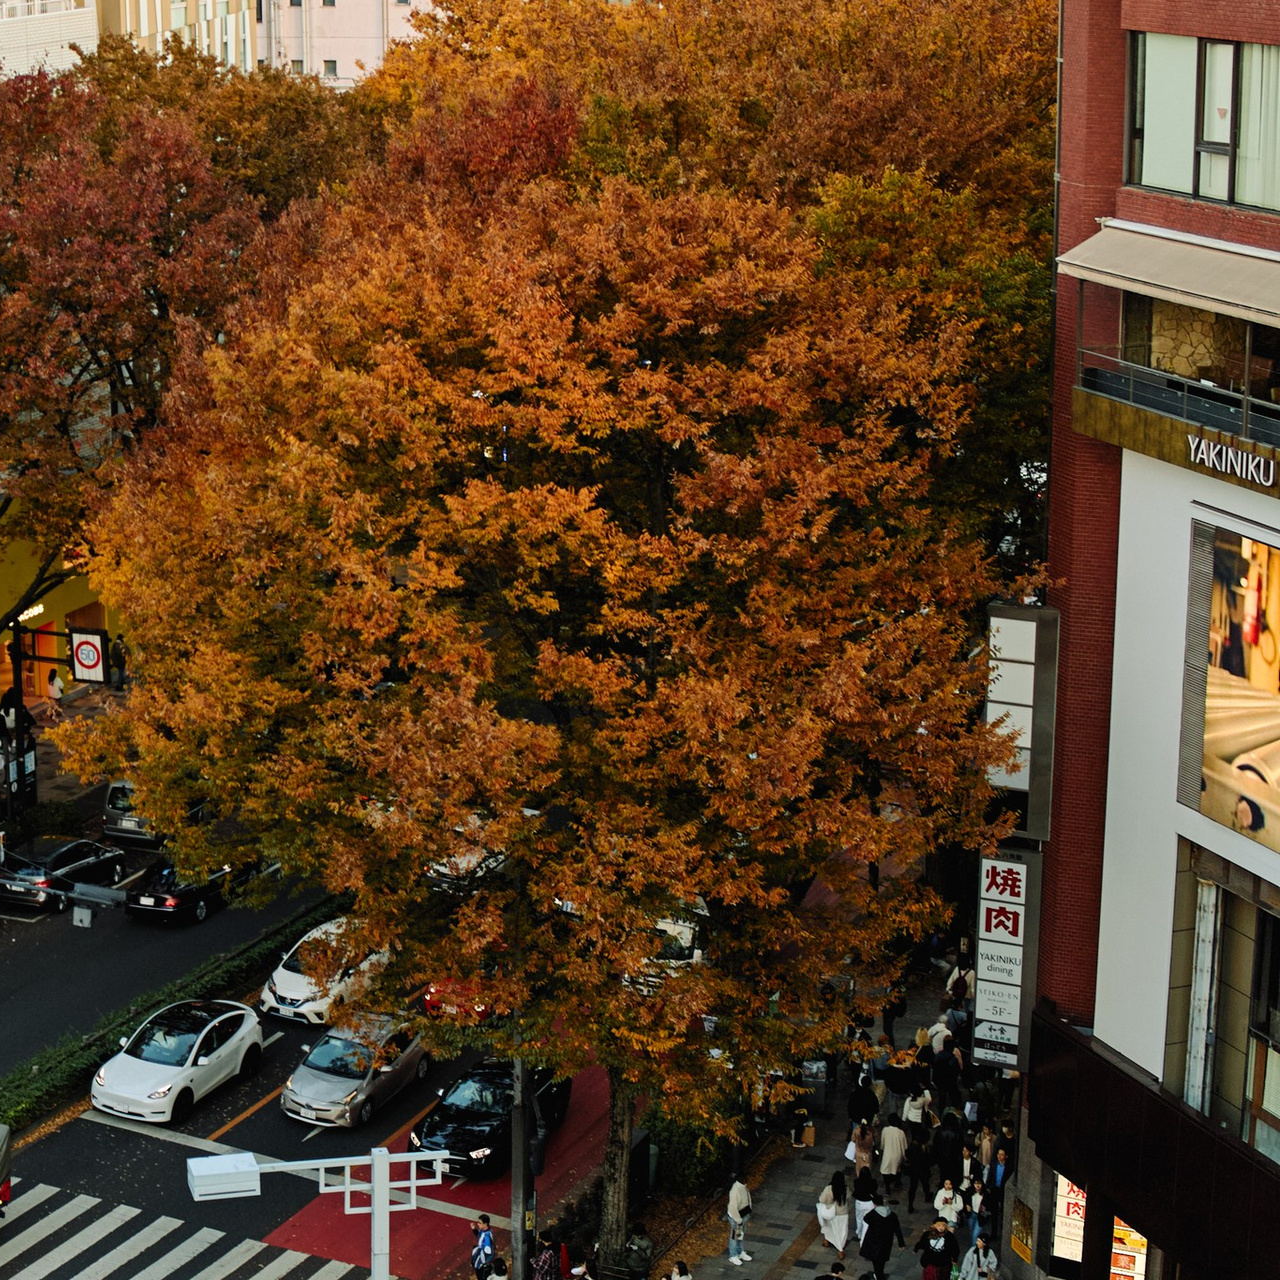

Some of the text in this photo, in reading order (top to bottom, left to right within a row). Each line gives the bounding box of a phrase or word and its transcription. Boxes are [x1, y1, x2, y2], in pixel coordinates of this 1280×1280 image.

[1187, 434, 1275, 487] YAKINIKU
[80, 648, 96, 662] 50
[985, 865, 1022, 938] 焼肉
[979, 952, 1022, 967] YAKINIKU
[986, 963, 1014, 977] dining
